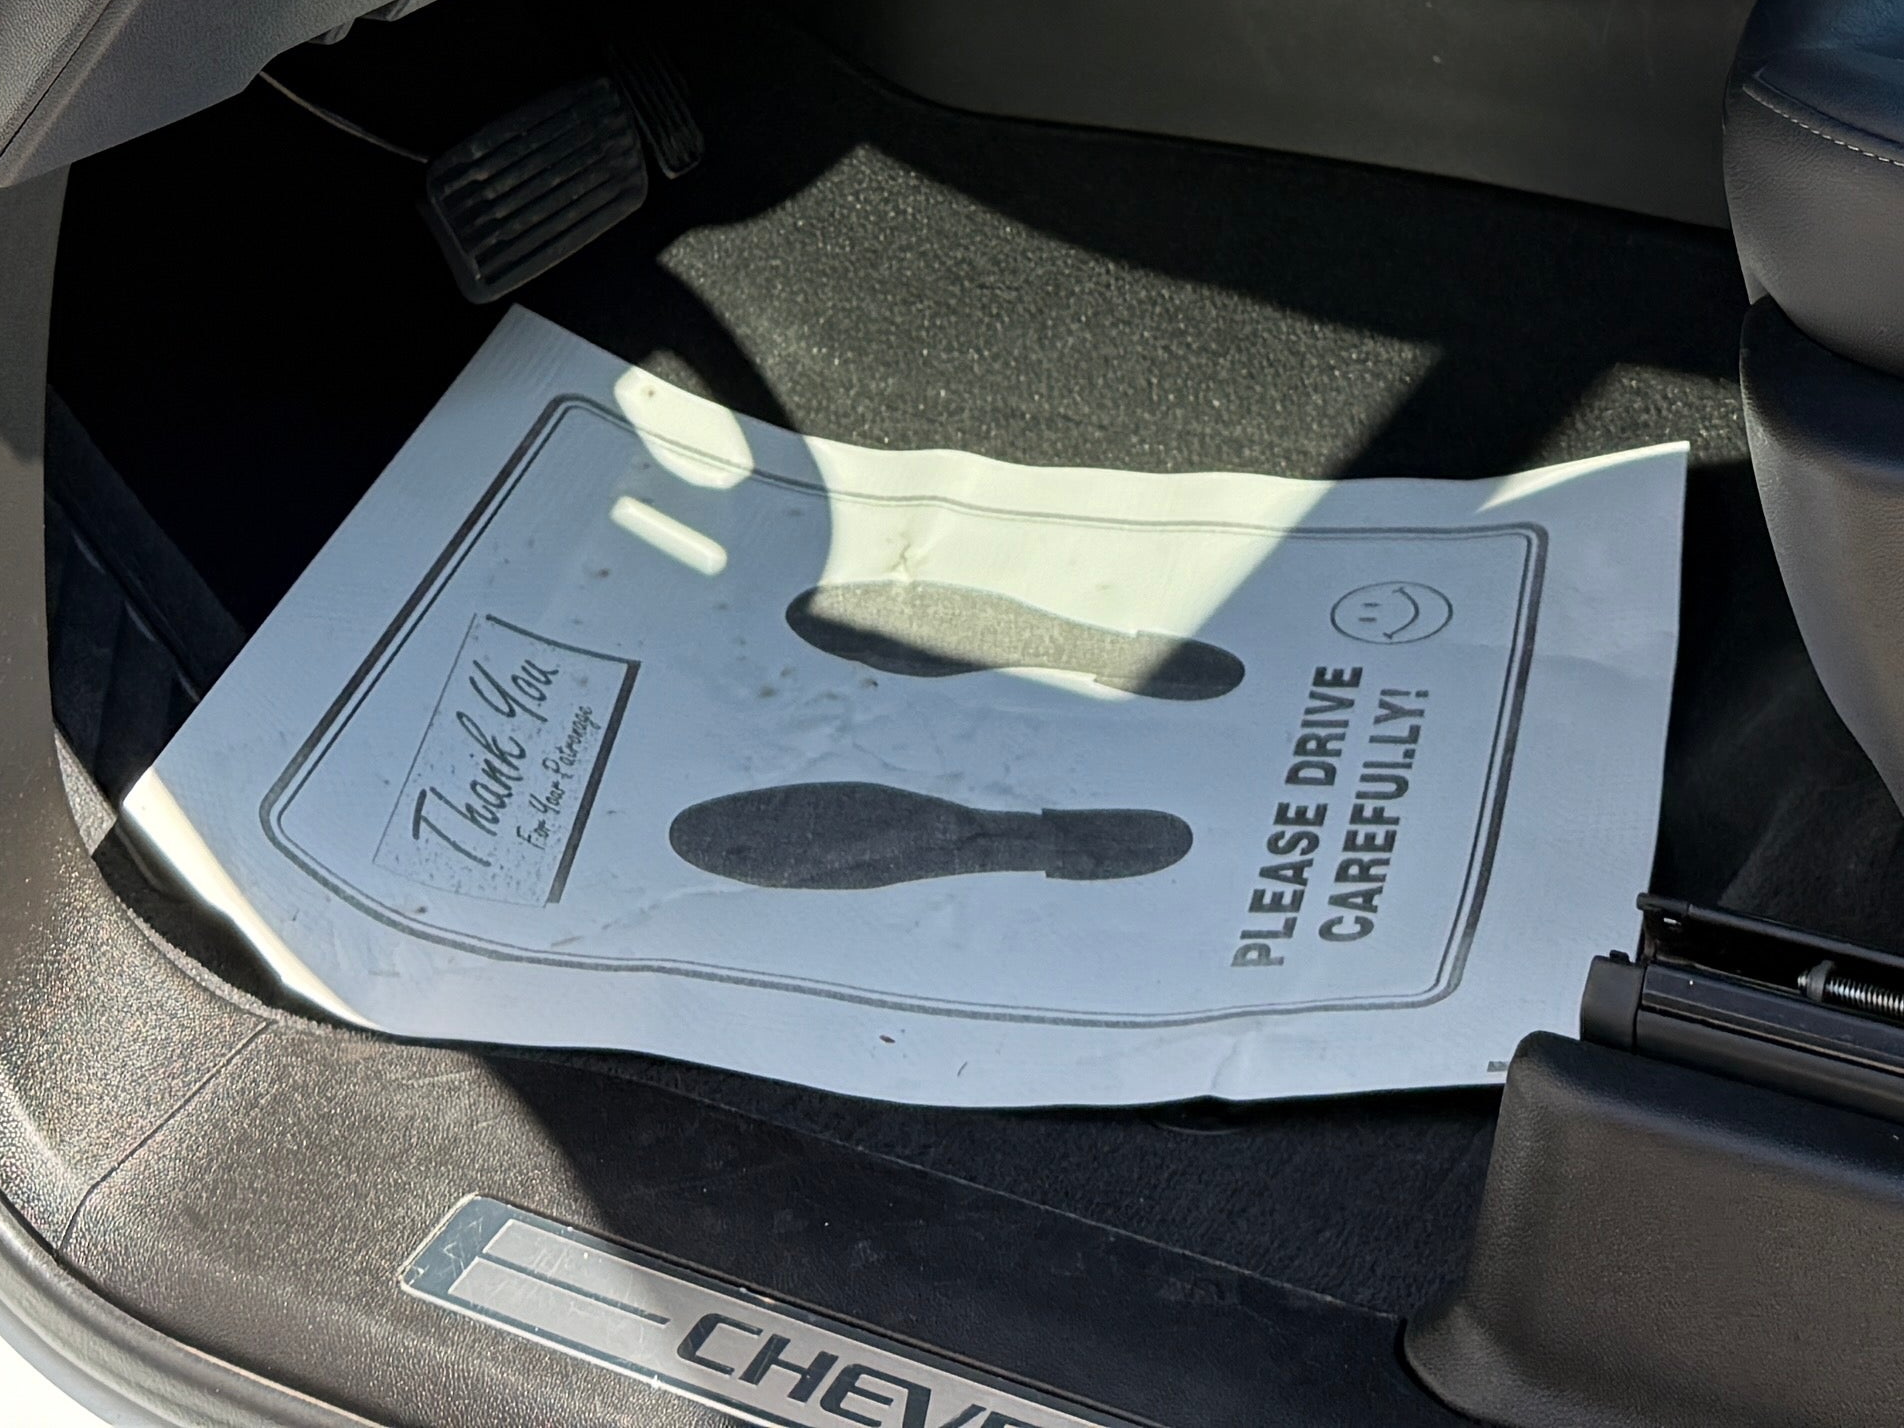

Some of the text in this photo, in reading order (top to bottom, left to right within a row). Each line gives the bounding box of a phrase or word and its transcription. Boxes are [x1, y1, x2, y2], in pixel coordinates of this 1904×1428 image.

[411, 658, 560, 868] Thank You
[516, 705, 603, 850] For Your Patronage
[1230, 665, 1364, 968] PLEASE DRIVE
[1317, 687, 1431, 943] CAREFULLY!
[676, 1312, 1031, 1428] CHEV
